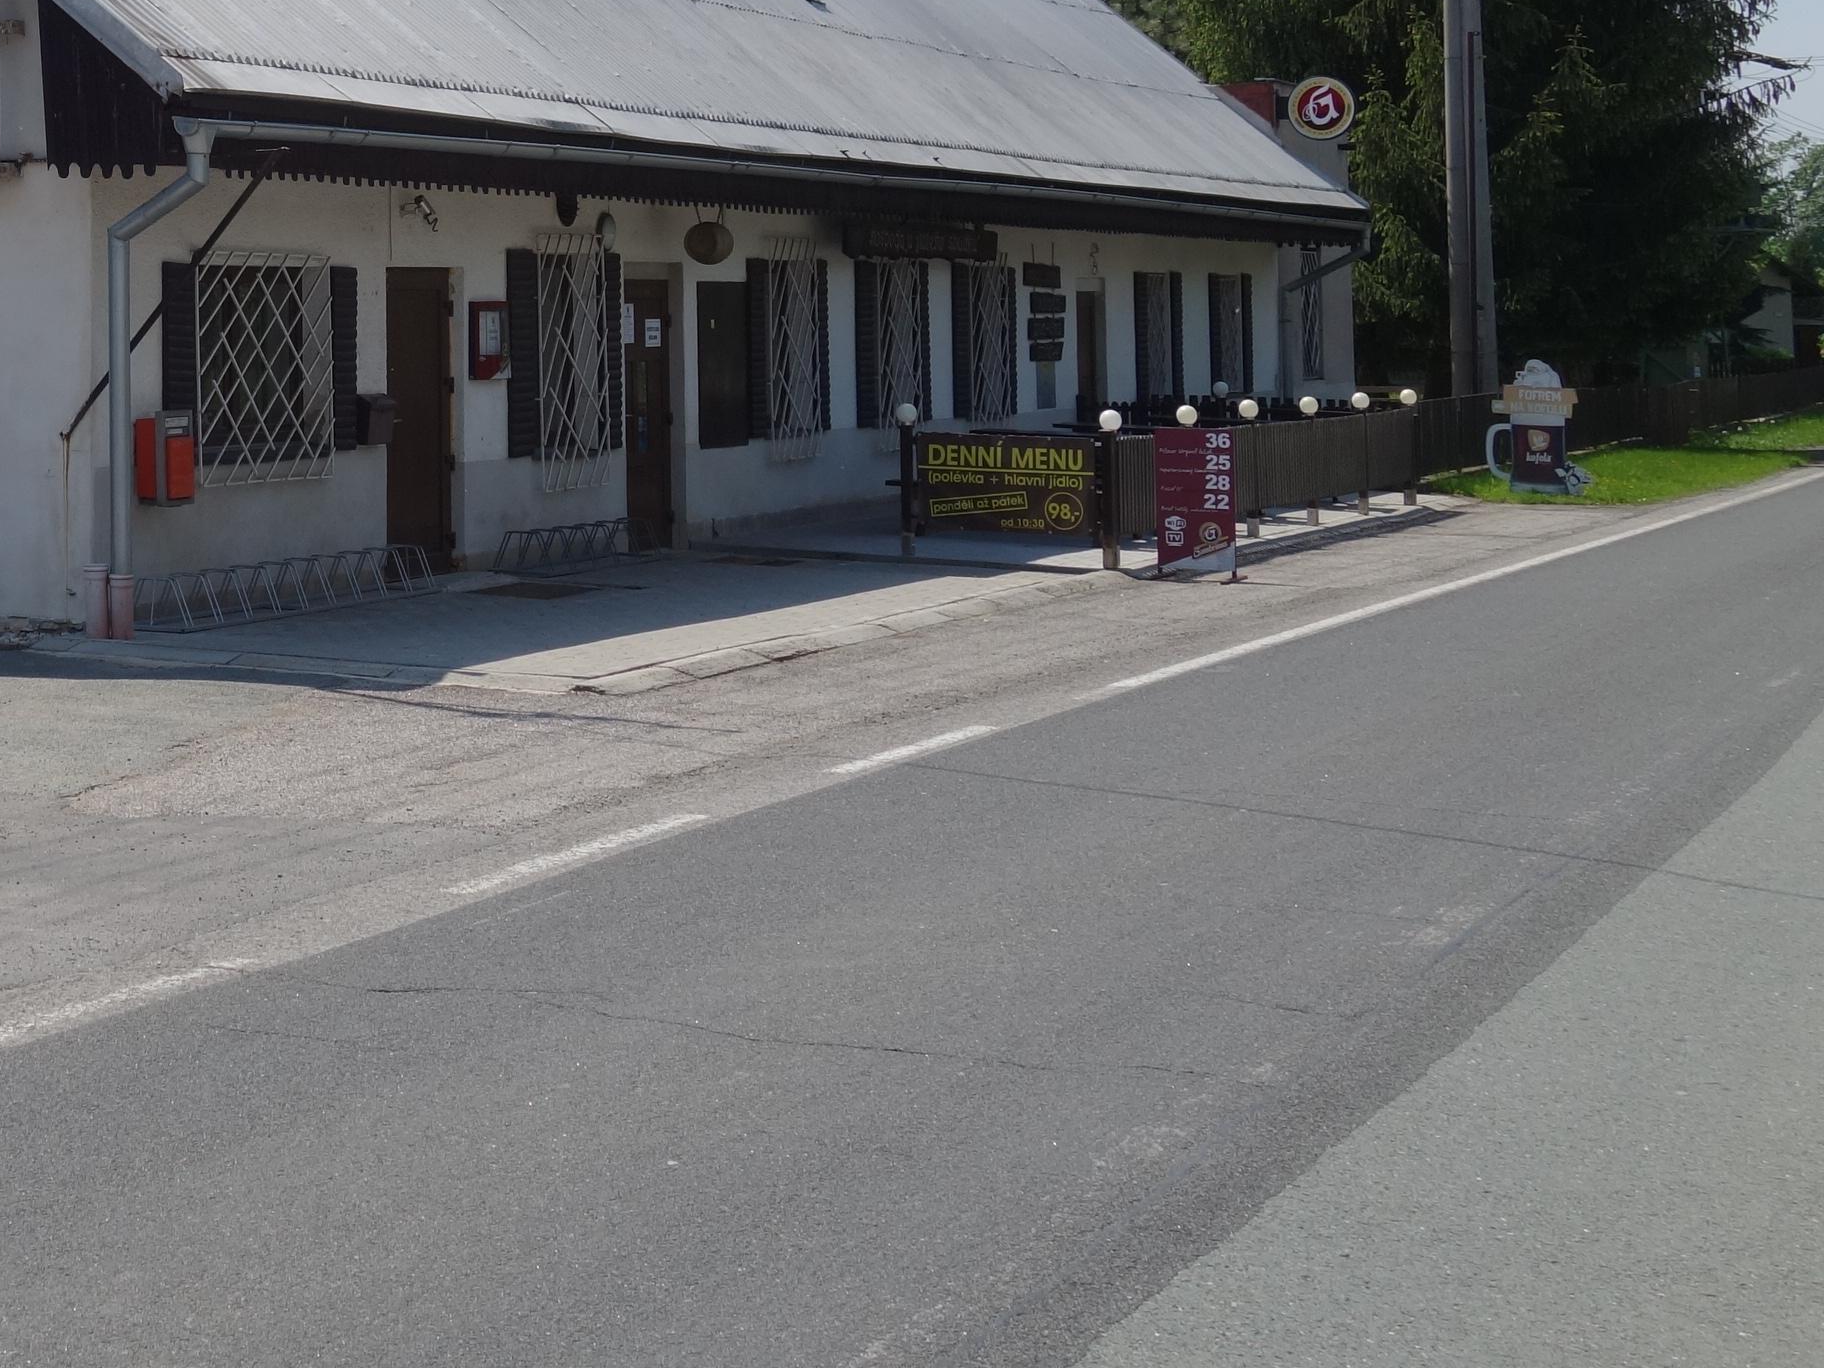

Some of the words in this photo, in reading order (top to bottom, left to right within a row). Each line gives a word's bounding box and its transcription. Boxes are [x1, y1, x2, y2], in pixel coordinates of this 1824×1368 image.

[1519, 390, 1562, 402] FOFREM
[1205, 433, 1231, 449] 36
[927, 441, 1003, 468] DENNÍ
[1011, 447, 1083, 471] MENU
[1205, 454, 1231, 470] 25
[927, 471, 984, 485] (polévka
[1004, 473, 1045, 487] hlavní
[1047, 475, 1084, 491] jídlo)
[1205, 474, 1231, 490] 28
[976, 497, 989, 509] až
[991, 494, 1025, 509] pátek
[1203, 494, 1230, 510] 22
[1047, 502, 1080, 522] 98,-
[1000, 518, 1014, 528] od
[1017, 518, 1045, 528] 10:30
